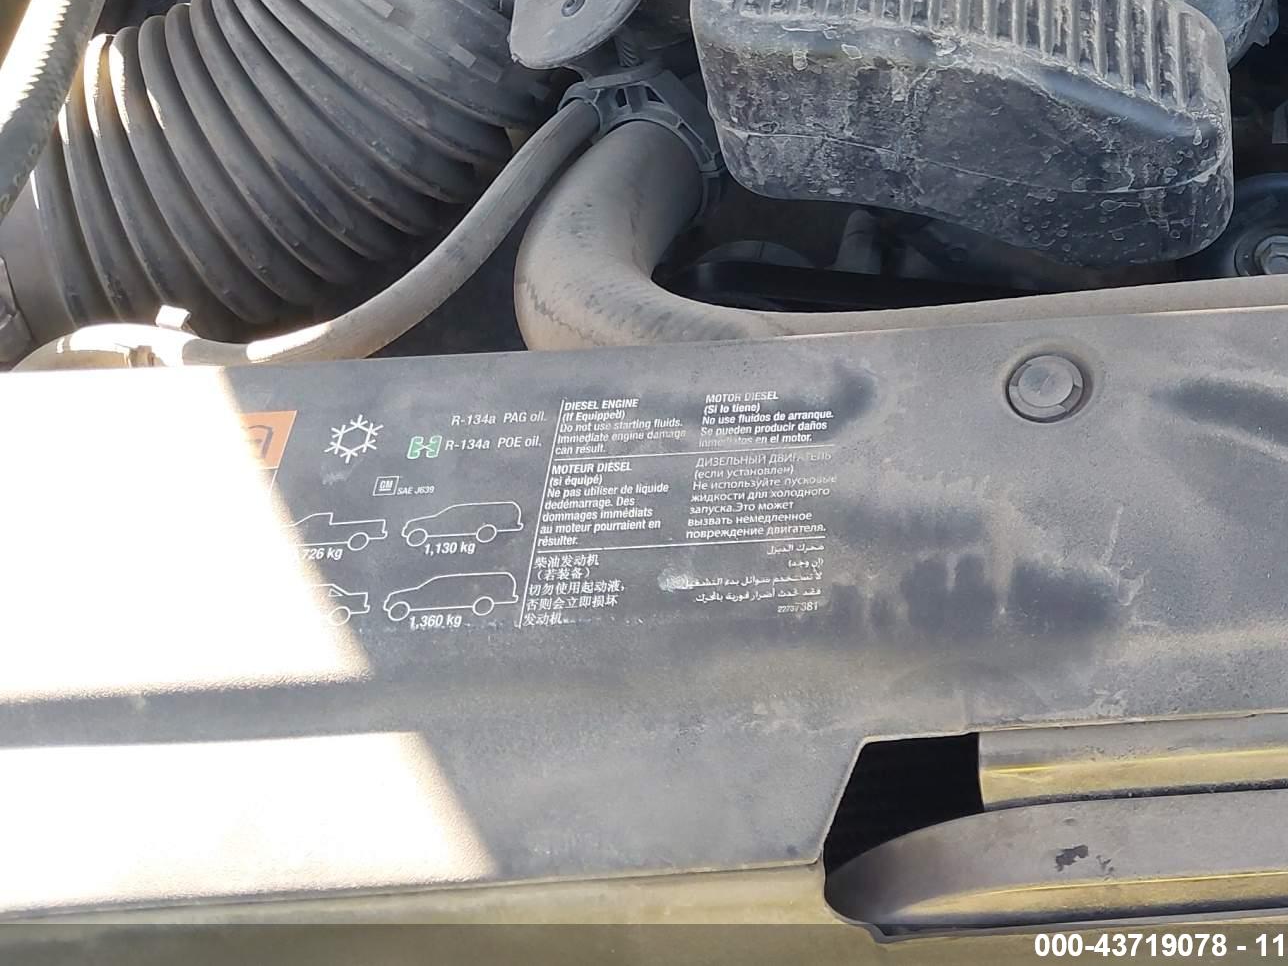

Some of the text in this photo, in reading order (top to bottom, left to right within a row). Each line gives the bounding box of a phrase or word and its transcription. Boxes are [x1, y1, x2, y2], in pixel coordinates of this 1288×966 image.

[706, 391, 779, 403] MOTOR DIESEL
[564, 399, 640, 411] DIESEL ENGINE
[704, 403, 760, 415] (Si lo tiene)
[451, 414, 496, 426] R-134a
[503, 412, 527, 423] PAG
[562, 410, 626, 423] (If Equipped)
[702, 410, 834, 425] No use fluidos de arranque.
[560, 418, 683, 433] Do not use starting fluids.
[700, 420, 827, 436] Se pueden producir daños
[445, 436, 542, 450] R-134a POE oil.
[557, 432, 609, 444] Immediate
[611, 432, 643, 442] engine
[755, 434, 768, 443] en
[770, 434, 780, 443] el
[782, 433, 813, 442] motor.
[555, 444, 606, 455] can result.
[551, 462, 632, 474] MOTEUR DIESEL
[695, 454, 766, 468] ДИЗЕЛЬНЫЙ
[694, 464, 793, 479] (если установлен)
[379, 480, 394, 490] GM
[549, 474, 603, 487] (si équipé)
[693, 481, 708, 490] Не
[711, 478, 780, 491] используйте
[397, 486, 435, 495] SAE J639
[547, 483, 669, 499] Ne pas utiliser de liquide
[690, 492, 745, 503] жидкости
[771, 487, 830, 498] холодного
[616, 497, 635, 506] Des
[758, 501, 794, 511] может
[543, 508, 653, 522] dommages immédiats
[688, 512, 812, 527] вызвать немедленное
[540, 520, 661, 534] au moteur pourraient en
[686, 523, 827, 540] повреждение двигателя.
[538, 535, 578, 547] résulter.
[326, 548, 343, 561] kg
[424, 541, 476, 556] 1,130 kg
[534, 554, 599, 569] 柴油发动机
[527, 594, 618, 611] 否则会立即损坏
[409, 615, 462, 630] 1,360 kg
